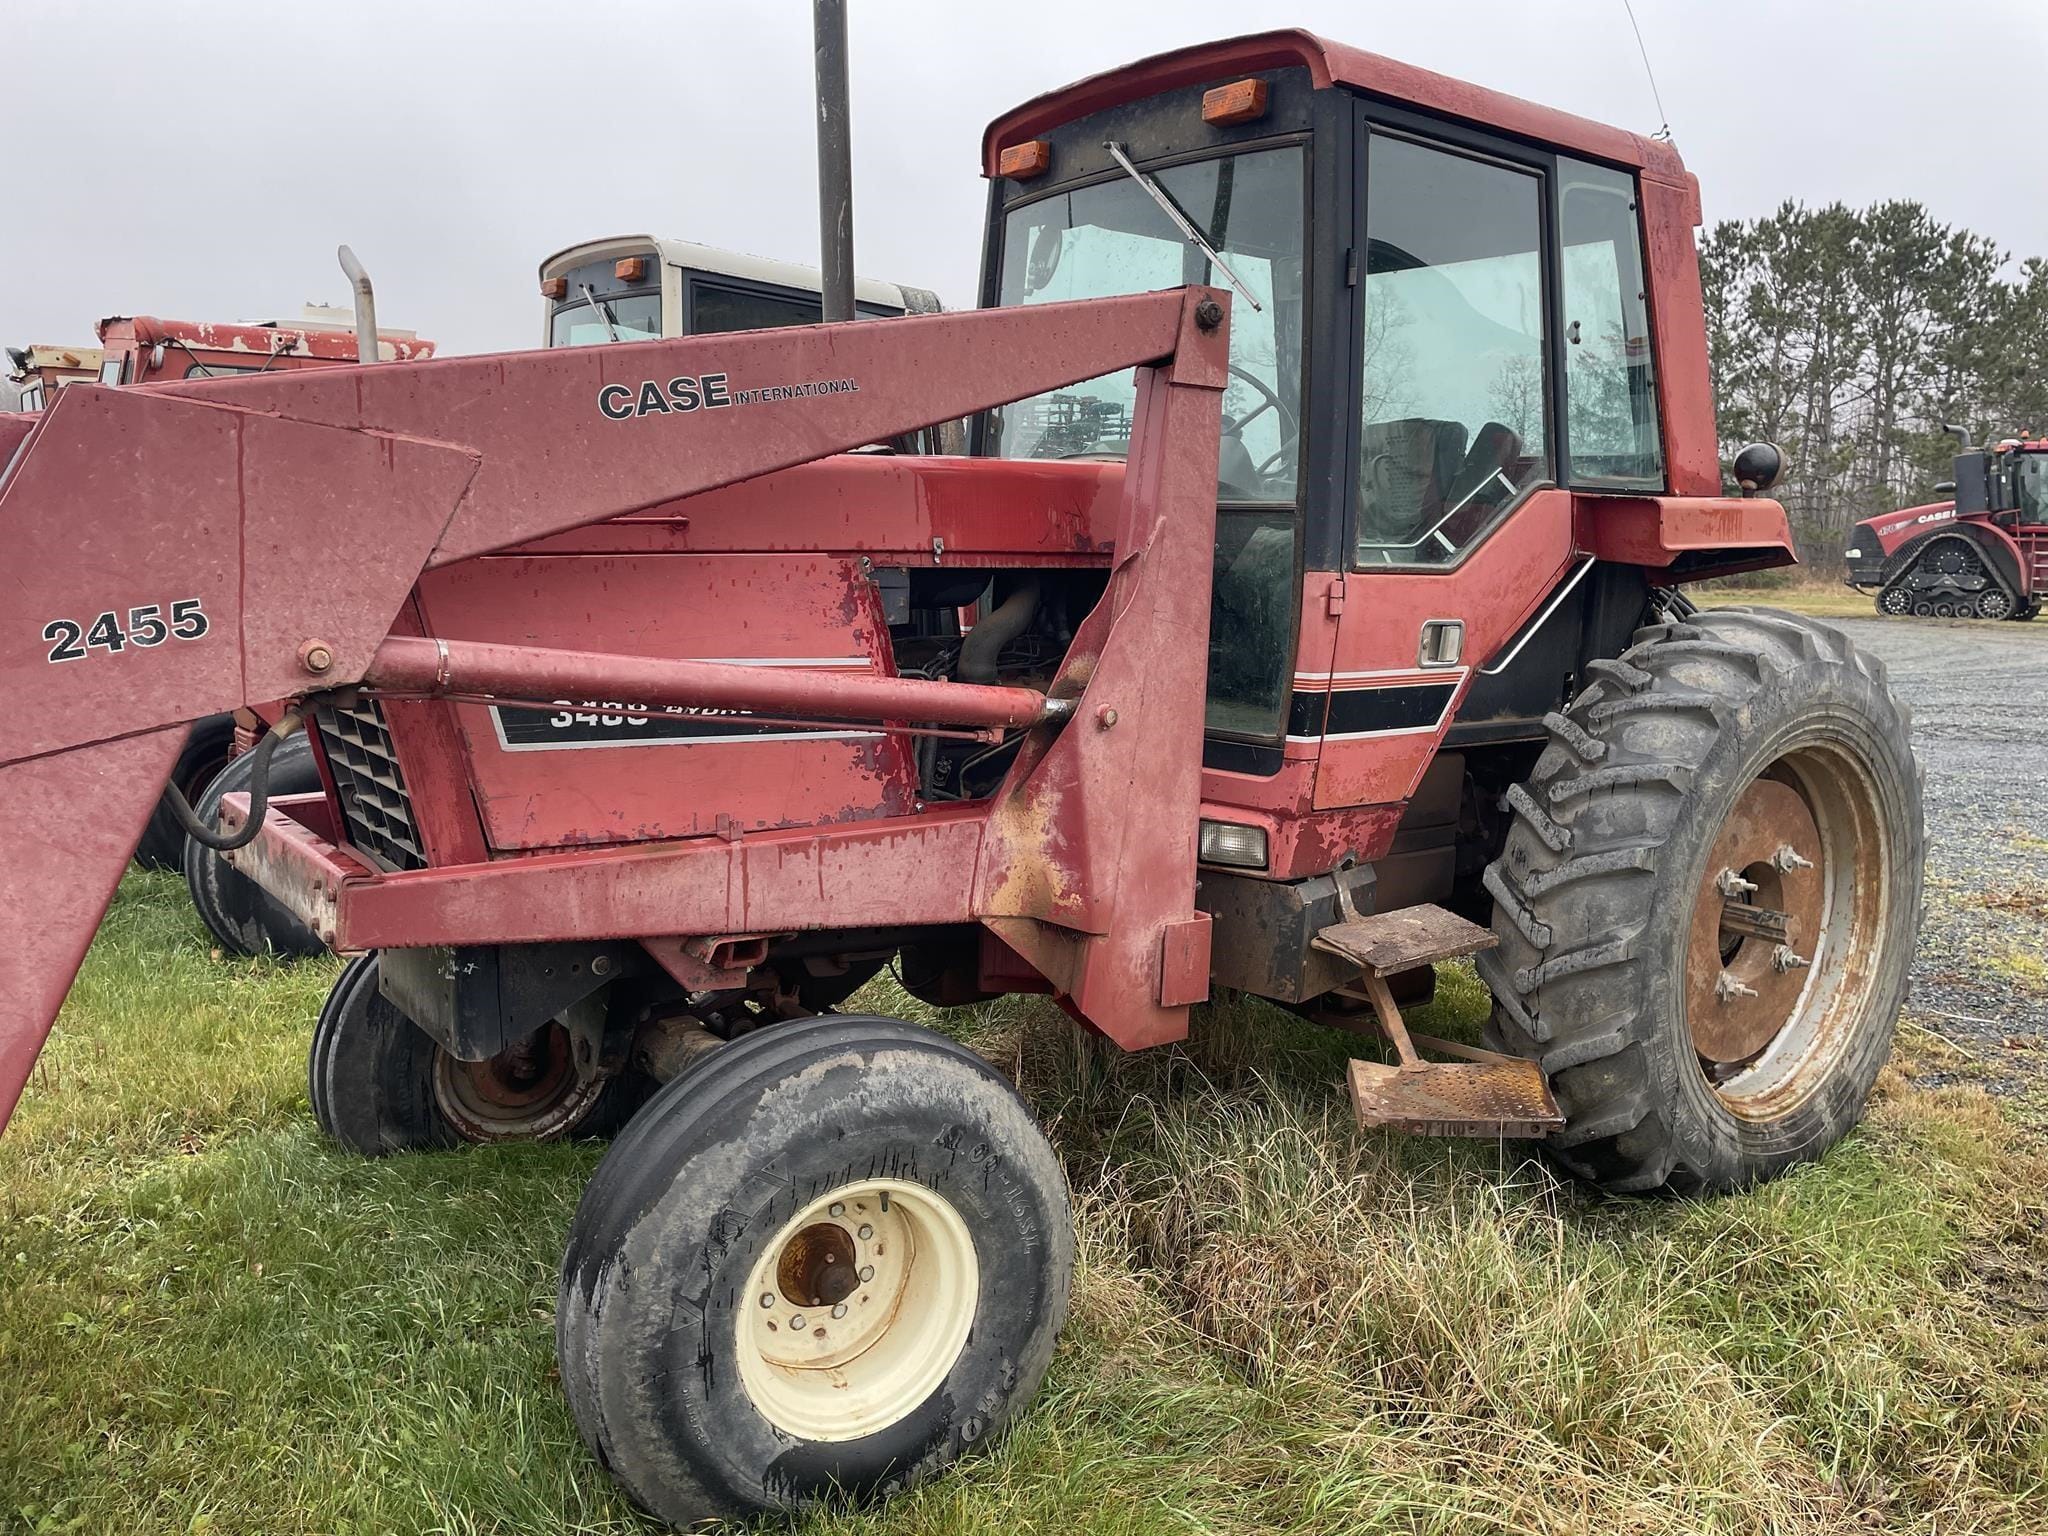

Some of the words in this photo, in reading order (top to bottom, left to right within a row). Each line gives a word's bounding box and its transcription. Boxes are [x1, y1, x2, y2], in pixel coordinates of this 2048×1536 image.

[597, 372, 731, 421] CASE
[733, 378, 860, 405] INTERNATIONAL
[1917, 510, 1951, 524] CASE
[42, 598, 210, 664] 2455
